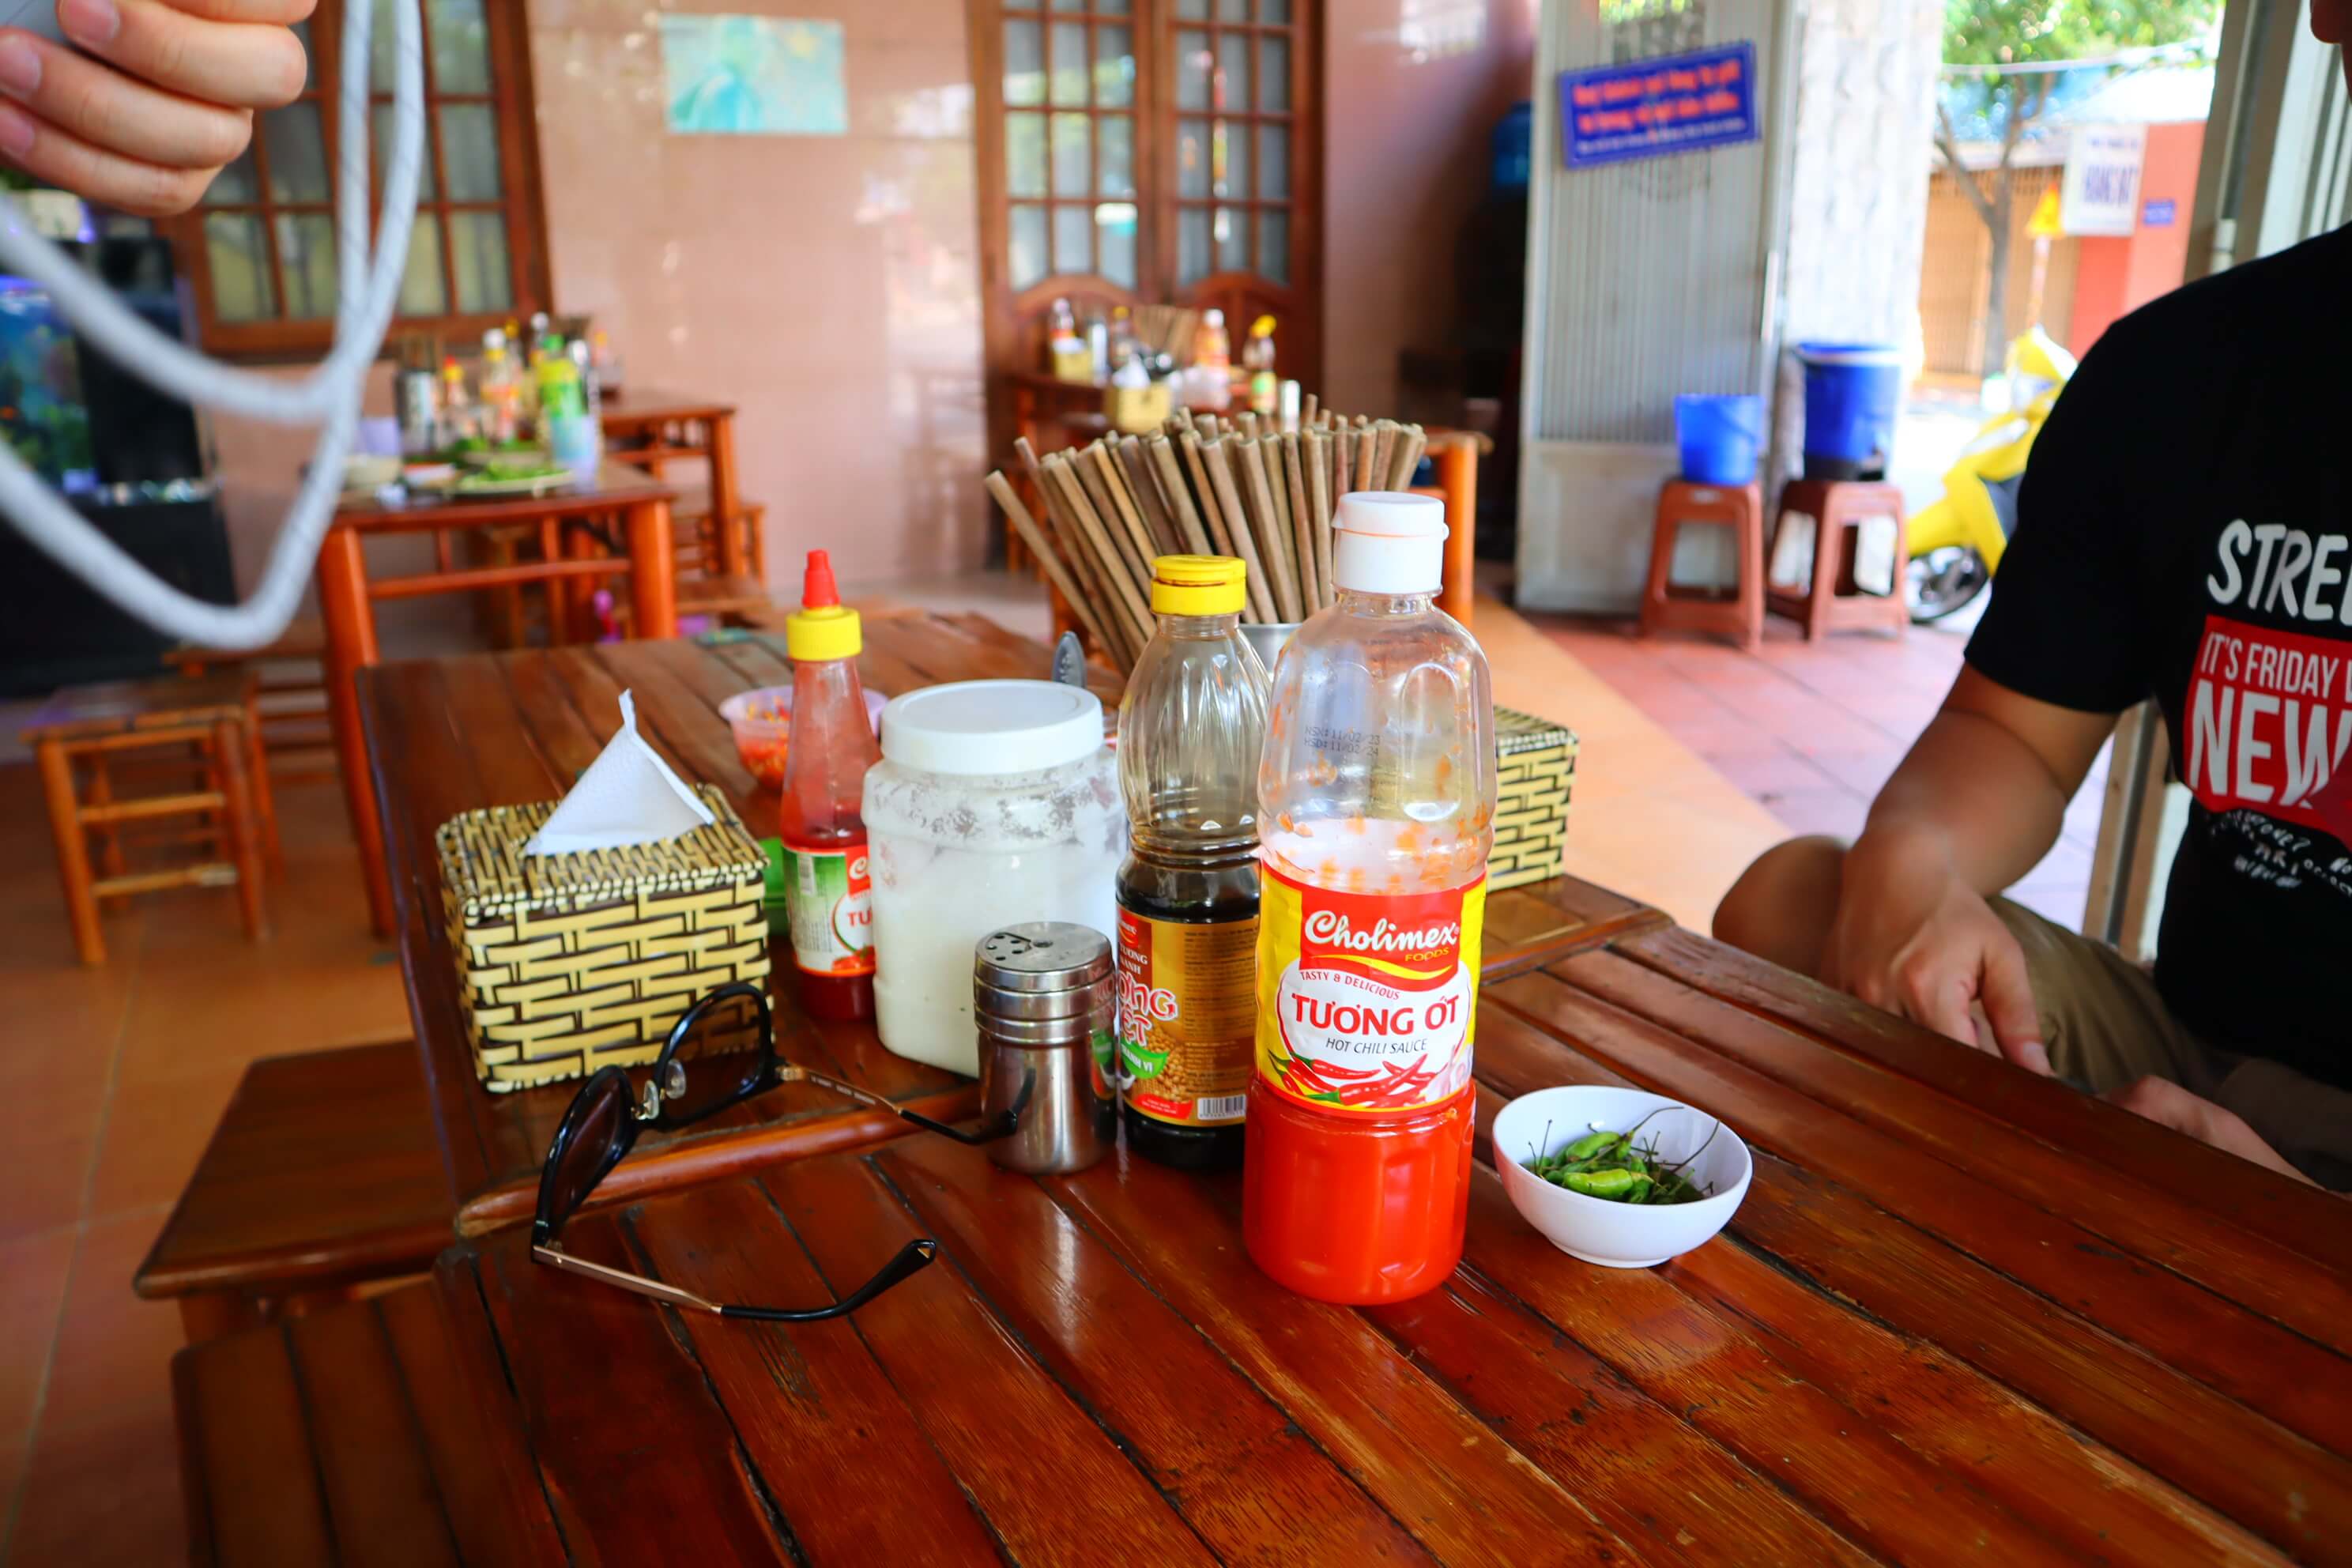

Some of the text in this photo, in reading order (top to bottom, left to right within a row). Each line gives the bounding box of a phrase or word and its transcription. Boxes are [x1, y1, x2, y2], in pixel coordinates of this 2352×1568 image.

[2200, 631, 2243, 681] IT'S
[2245, 642, 2339, 699] FRIDAY
[1305, 910, 1459, 951] Cholimex
[1405, 947, 1449, 962] FOODS
[1301, 971, 1329, 981] TASTY
[1344, 975, 1400, 1000] DELICIOUS
[1325, 1037, 1427, 1054] HOT CHILI SAUCE
